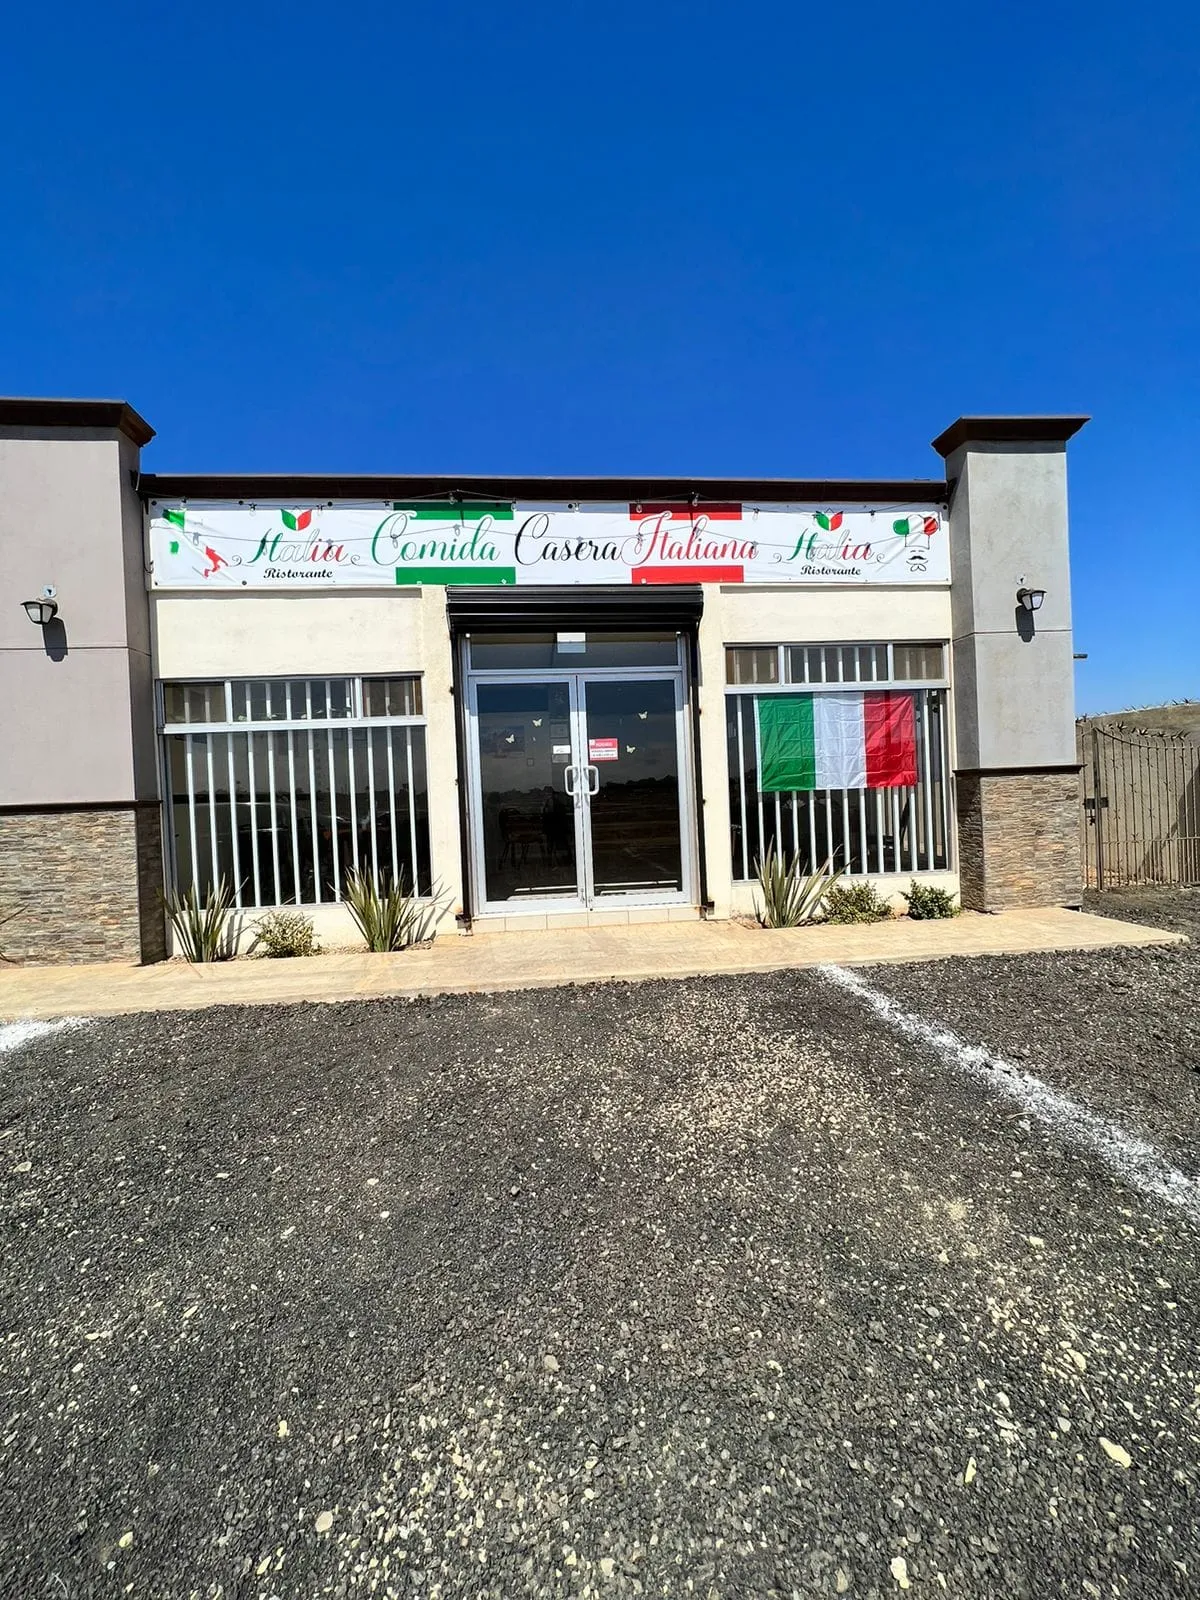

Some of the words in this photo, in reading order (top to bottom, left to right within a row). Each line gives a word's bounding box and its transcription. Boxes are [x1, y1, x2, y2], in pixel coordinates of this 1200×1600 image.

[247, 528, 349, 564] Italia
[371, 512, 501, 566] Comida
[514, 512, 622, 566] Casera
[620, 511, 759, 566] Italiana
[786, 528, 875, 561] Italia
[263, 567, 333, 579] Ristorante
[800, 564, 862, 576] Ristorante
